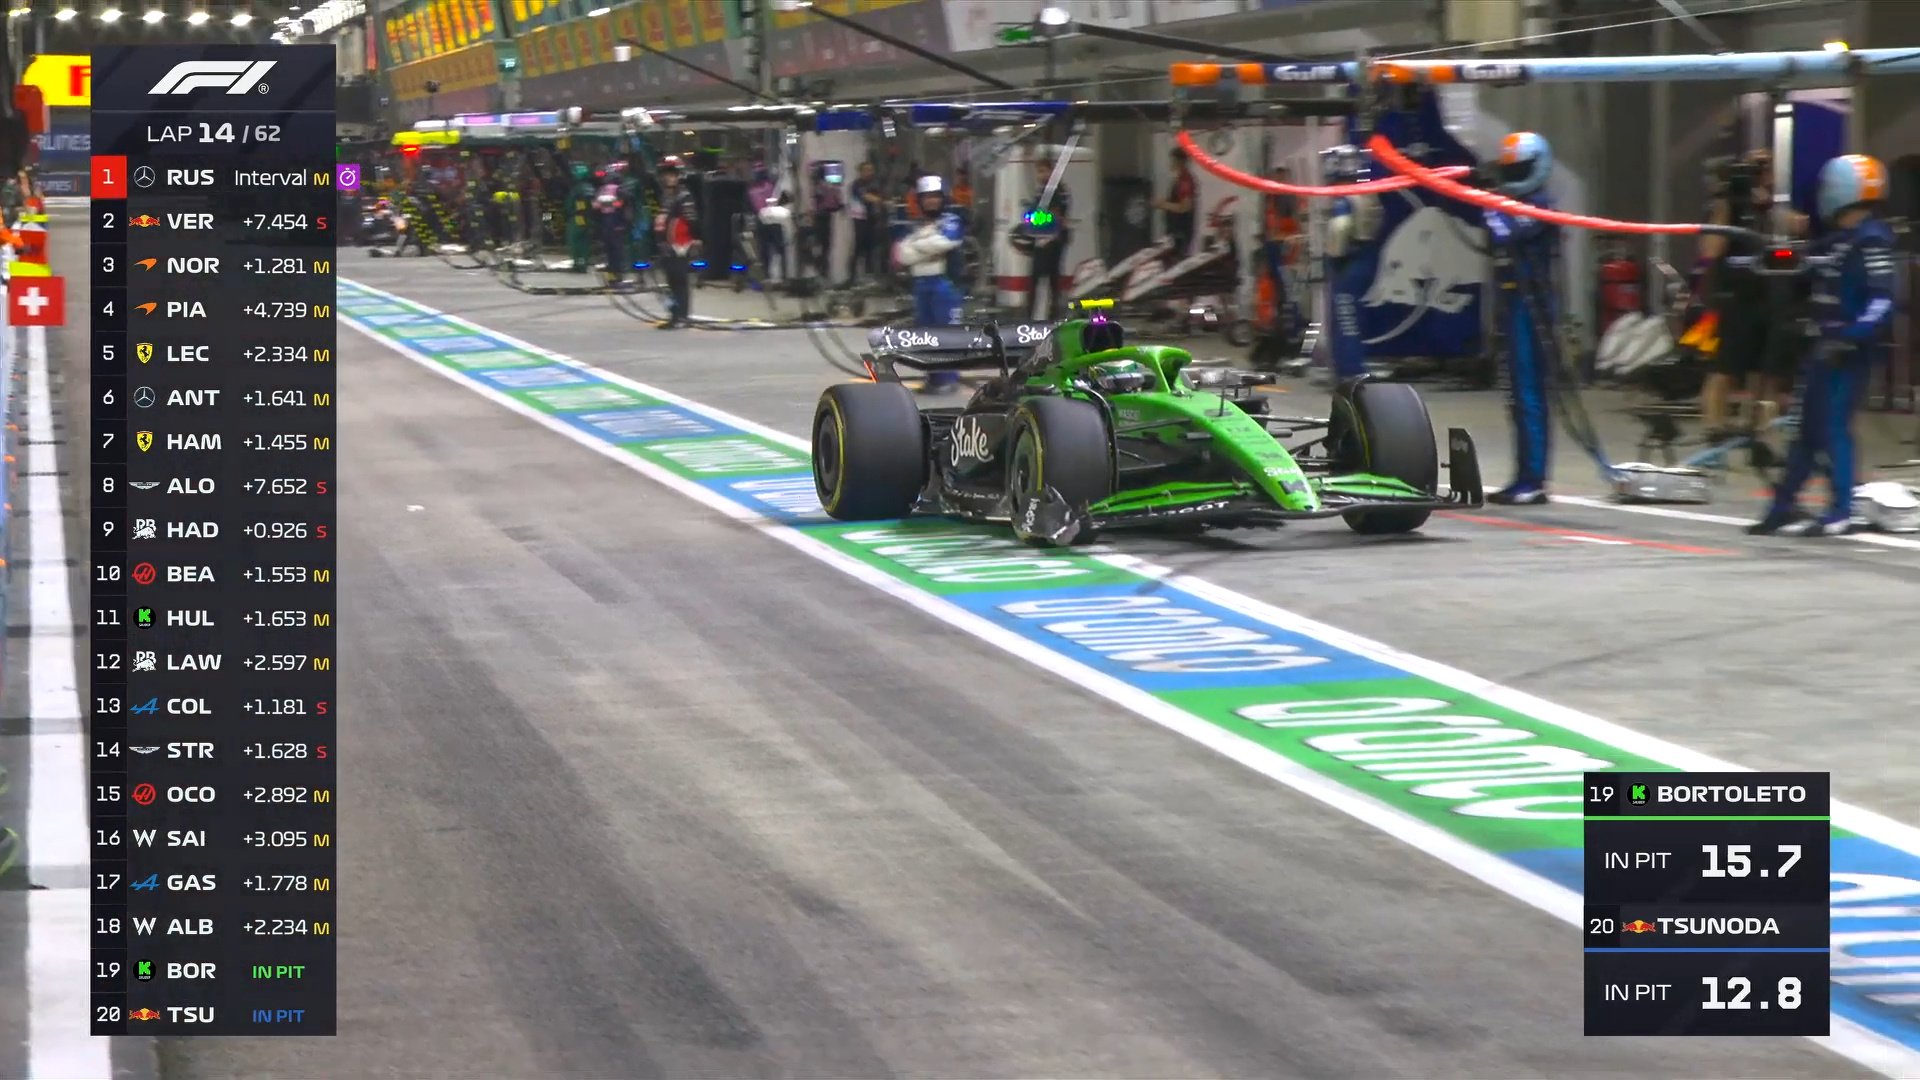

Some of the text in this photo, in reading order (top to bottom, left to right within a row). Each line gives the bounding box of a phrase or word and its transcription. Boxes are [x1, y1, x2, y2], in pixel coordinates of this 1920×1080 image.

[898, 331, 940, 348] Stake
[1016, 325, 1052, 344] Stak
[950, 415, 994, 467] Stake
